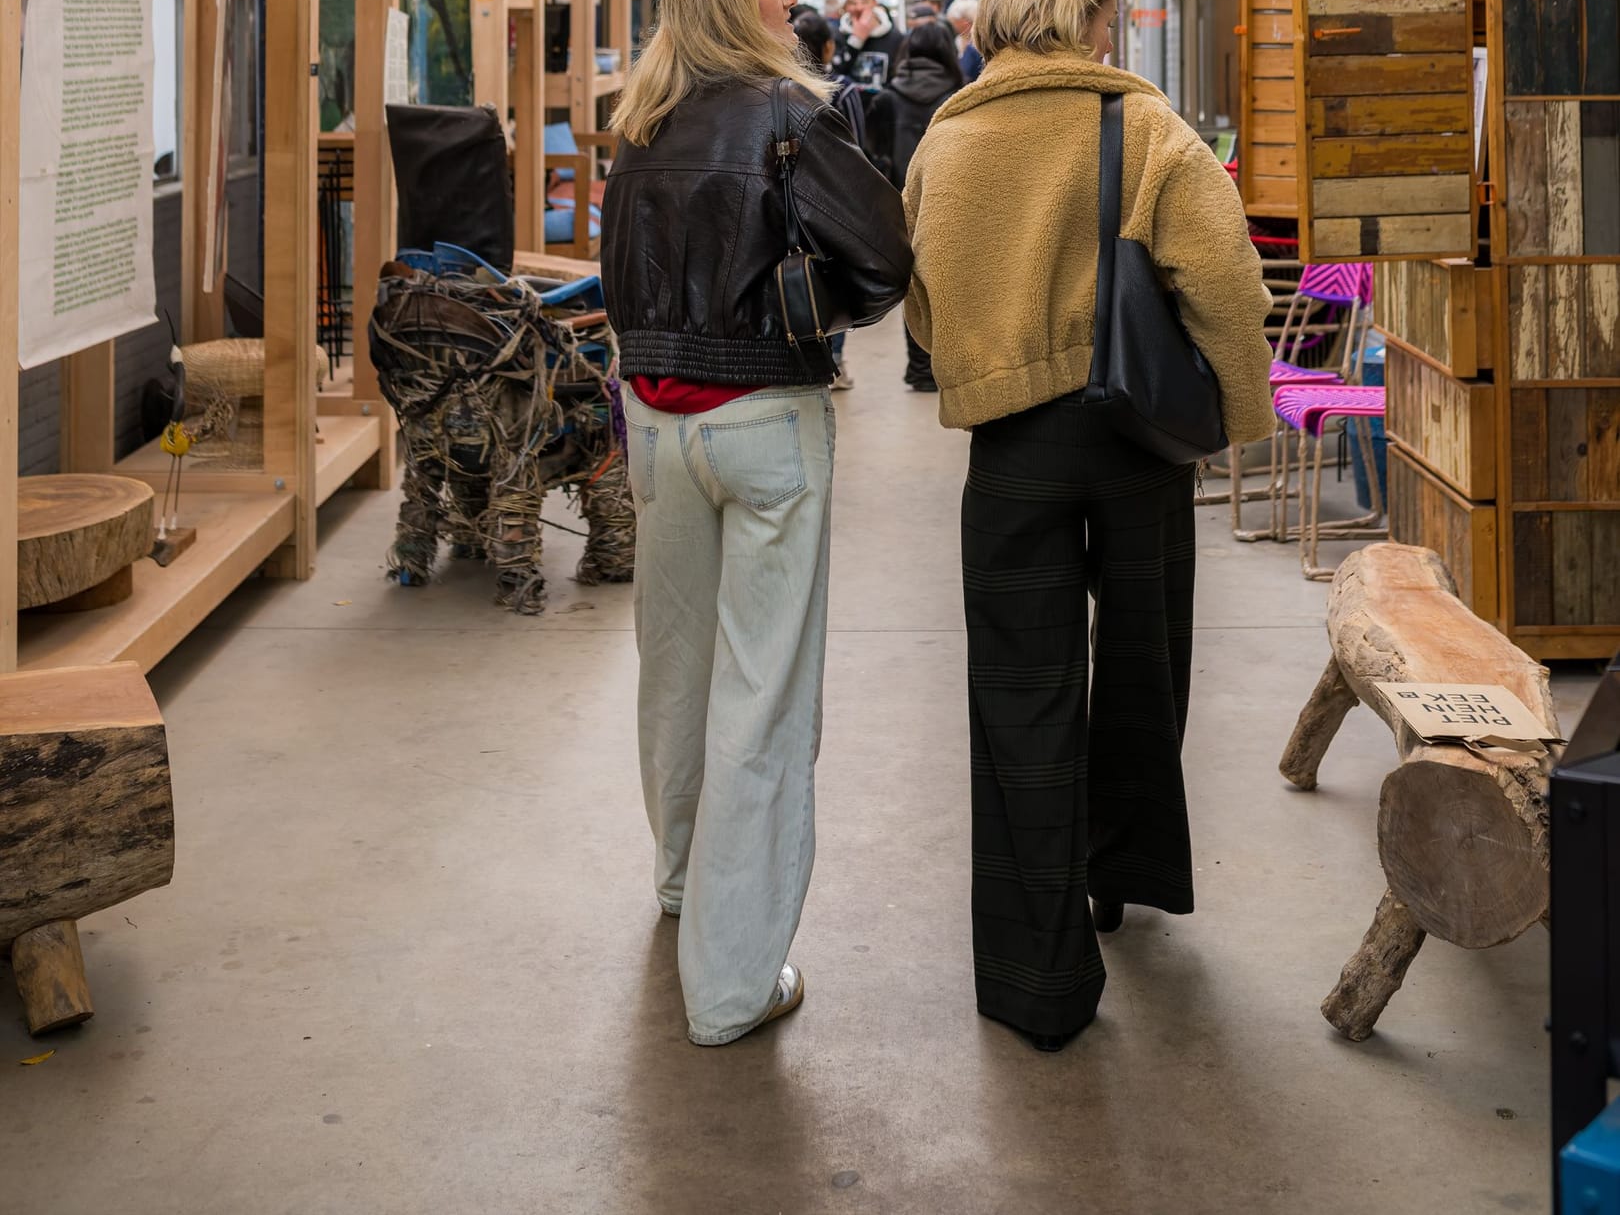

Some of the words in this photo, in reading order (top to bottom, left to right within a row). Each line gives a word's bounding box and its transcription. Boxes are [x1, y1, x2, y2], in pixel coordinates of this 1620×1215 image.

[1424, 693, 1490, 703] EEK
[1421, 703, 1501, 715] HEIN
[1441, 713, 1512, 726] PIET
